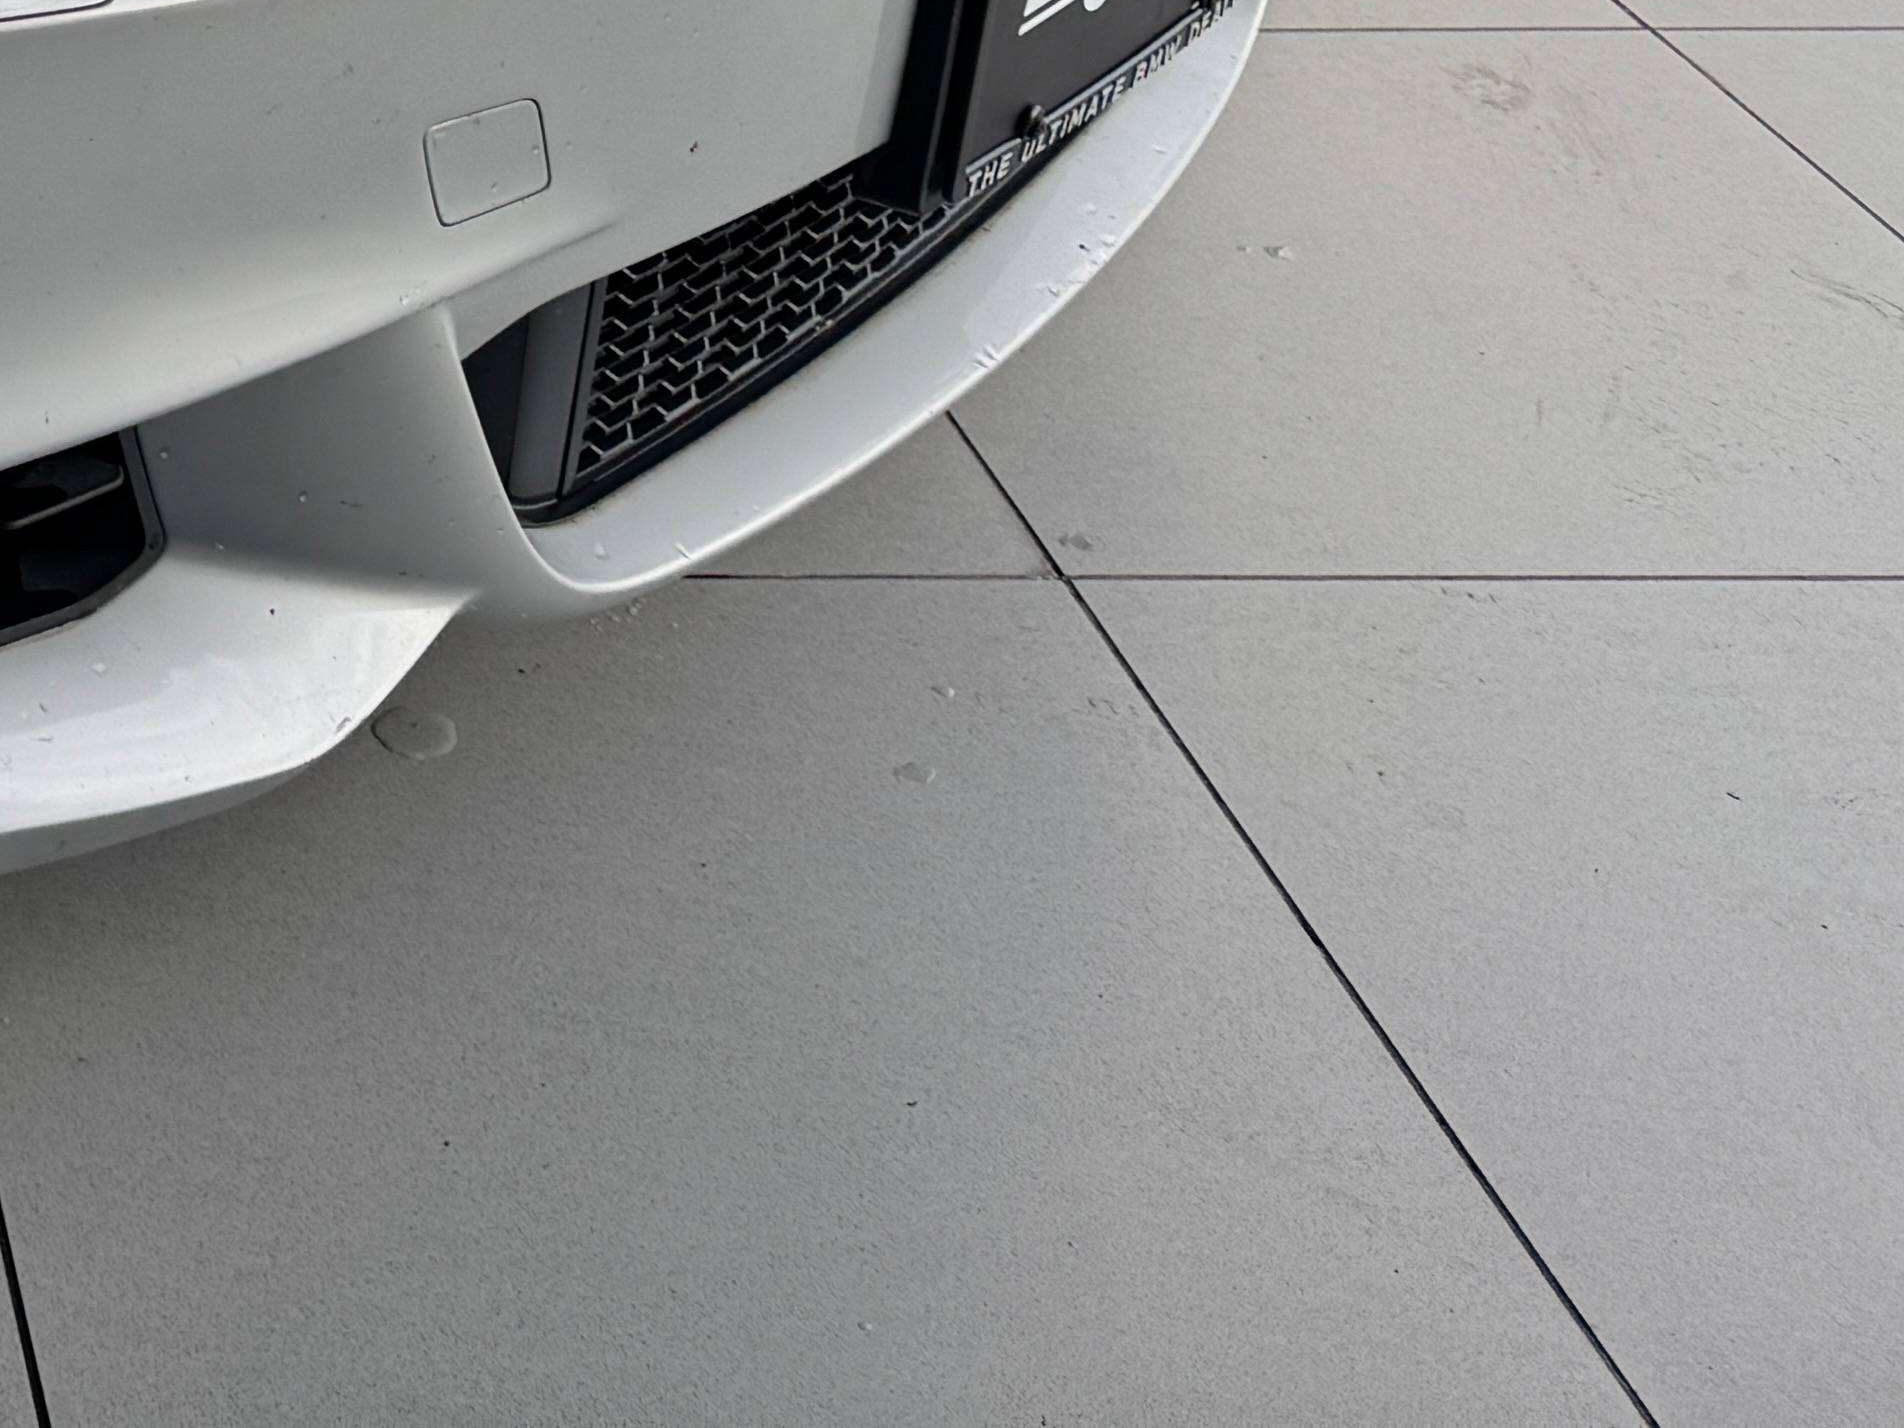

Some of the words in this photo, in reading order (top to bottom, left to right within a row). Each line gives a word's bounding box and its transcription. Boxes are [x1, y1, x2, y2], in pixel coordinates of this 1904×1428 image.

[967, 151, 1013, 198] THE
[1021, 75, 1127, 164] ULTIMATE
[1135, 34, 1182, 82] BMW
